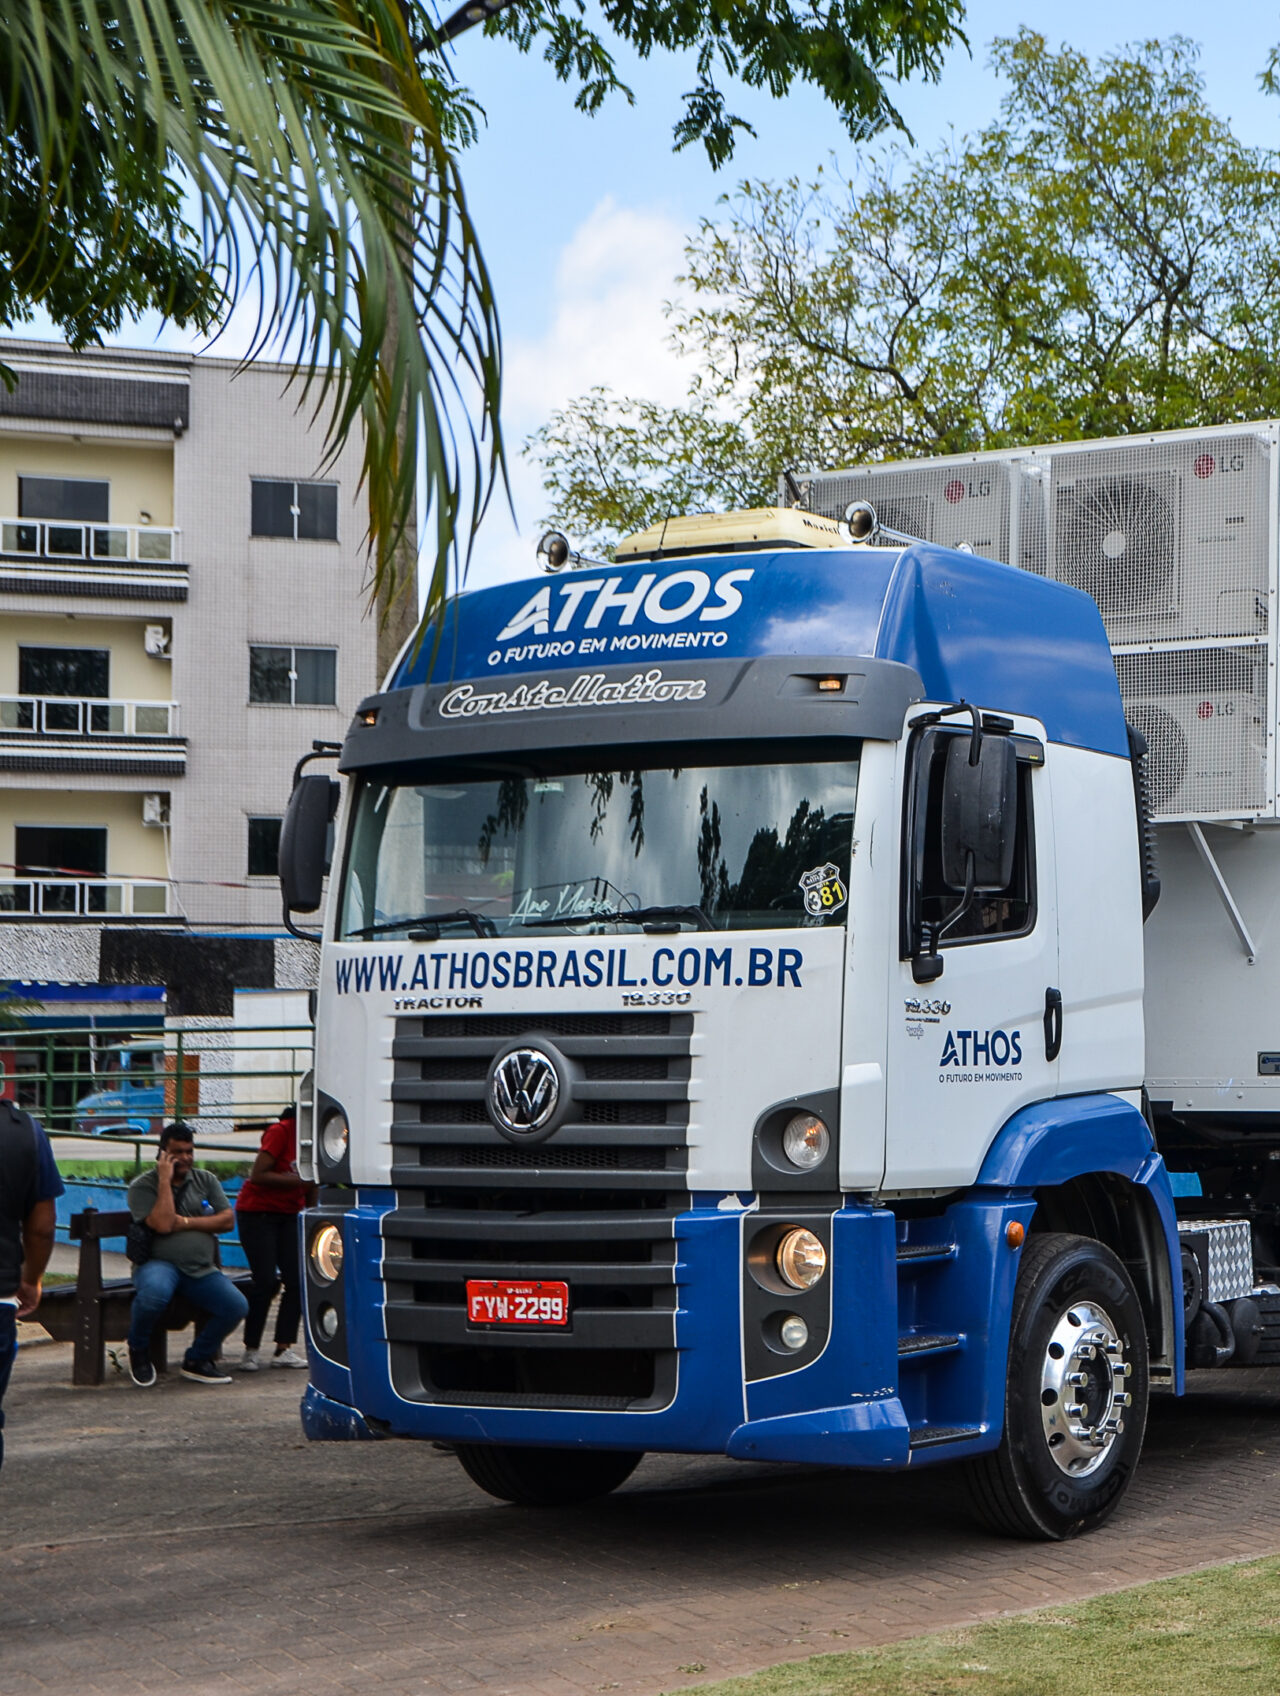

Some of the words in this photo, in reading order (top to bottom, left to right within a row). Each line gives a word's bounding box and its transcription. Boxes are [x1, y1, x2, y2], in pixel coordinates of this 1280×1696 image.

[1220, 455, 1244, 472] LG
[968, 481, 991, 498] LG
[496, 568, 755, 641] ATHOS
[487, 650, 502, 666] O
[504, 640, 576, 663] FUTURO
[578, 637, 607, 654] EM
[610, 631, 728, 651] MOVIMENTO
[438, 668, 706, 718] Constellation
[808, 881, 844, 910] 381
[335, 946, 805, 996] WWW.ATHOSBRASIL.COM.BR
[394, 994, 483, 1010] TRACTOR
[939, 1029, 1023, 1067] ATHOS
[939, 1074, 946, 1083] O
[946, 1073, 973, 1083] FUTURO
[974, 1073, 984, 1082] EM
[985, 1072, 1023, 1082] MOVIMENTO
